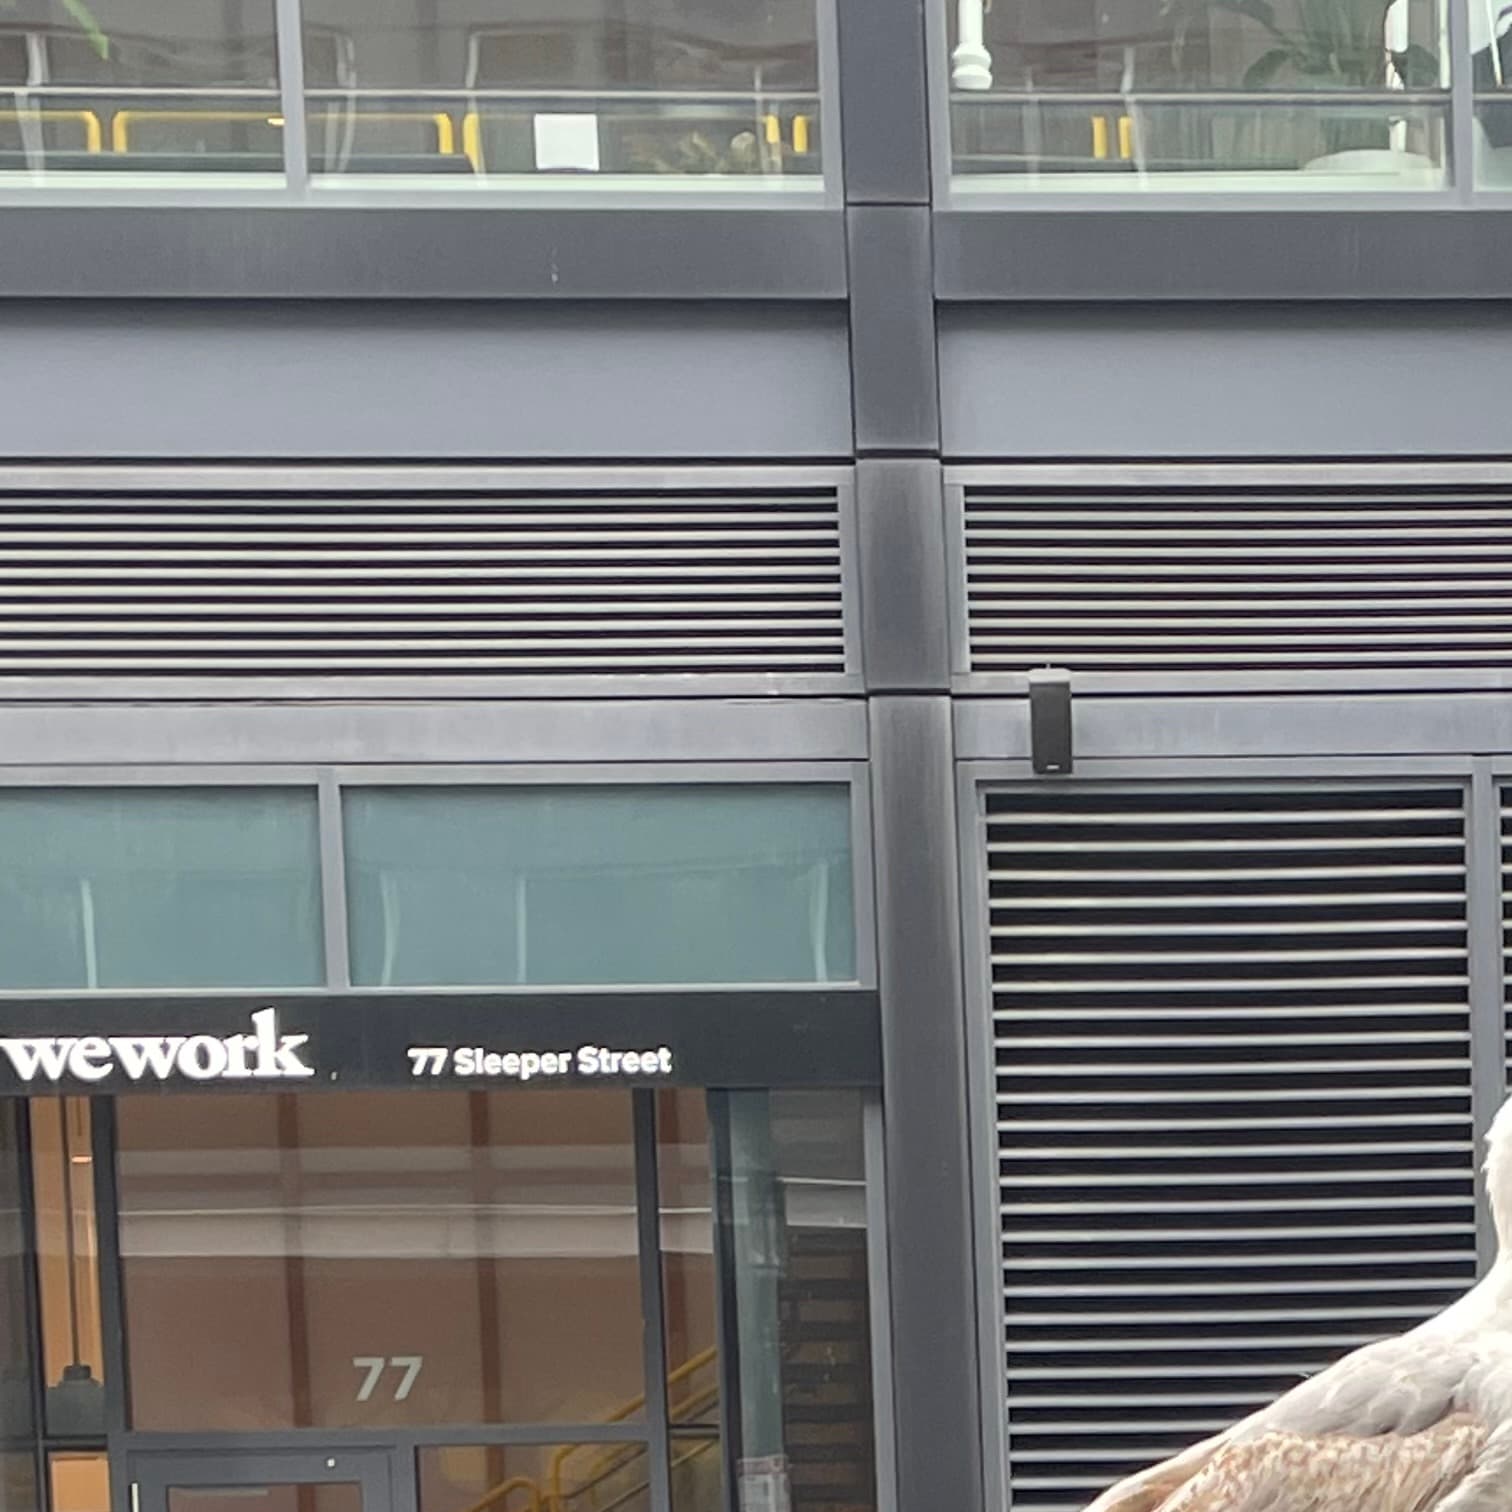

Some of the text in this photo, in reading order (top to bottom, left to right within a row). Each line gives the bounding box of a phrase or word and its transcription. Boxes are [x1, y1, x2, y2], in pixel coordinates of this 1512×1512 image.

[0, 1006, 315, 1081] wework
[407, 1045, 672, 1081] 77 Sleeper Street
[353, 1355, 423, 1402] 77
